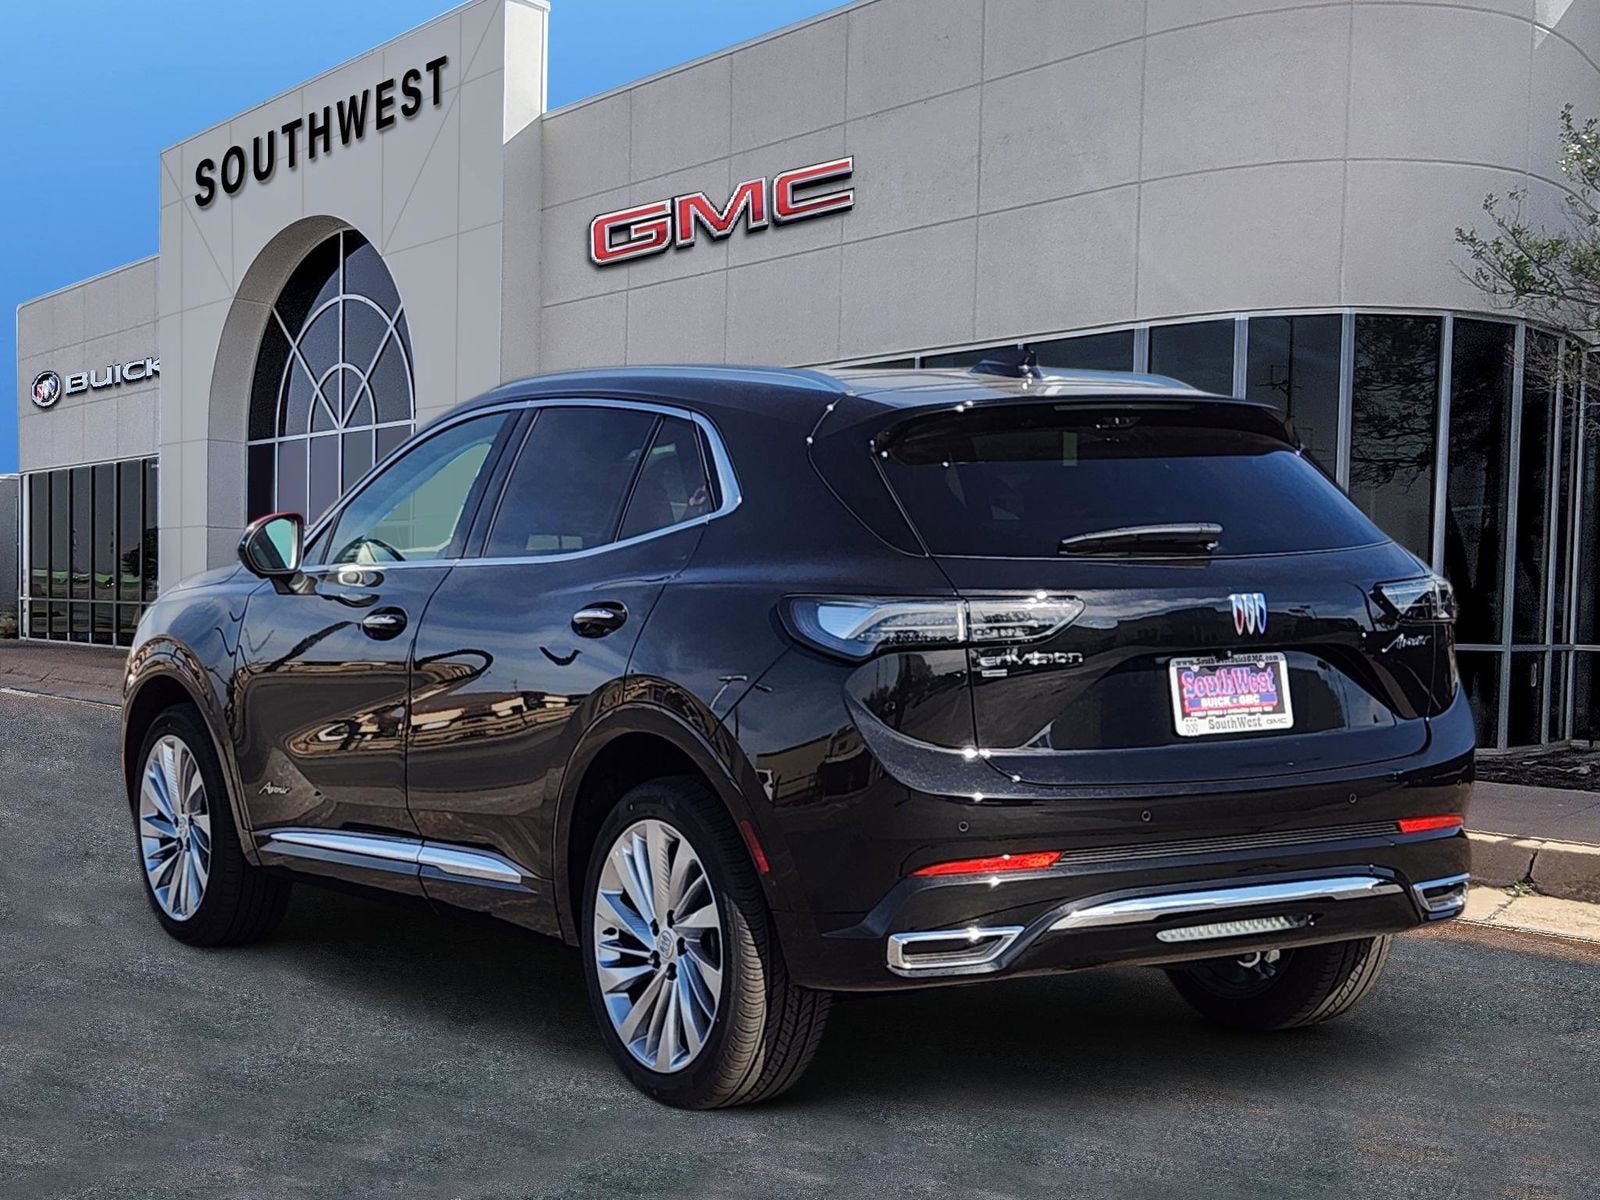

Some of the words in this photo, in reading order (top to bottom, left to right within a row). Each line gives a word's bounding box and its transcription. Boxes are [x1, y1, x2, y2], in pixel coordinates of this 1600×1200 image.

[194, 55, 448, 207] SOUTHWEST
[589, 156, 855, 265] GMC
[65, 357, 160, 395] BUICK
[1181, 667, 1275, 698] SouthWest
[1208, 717, 1262, 731] SouthWest
